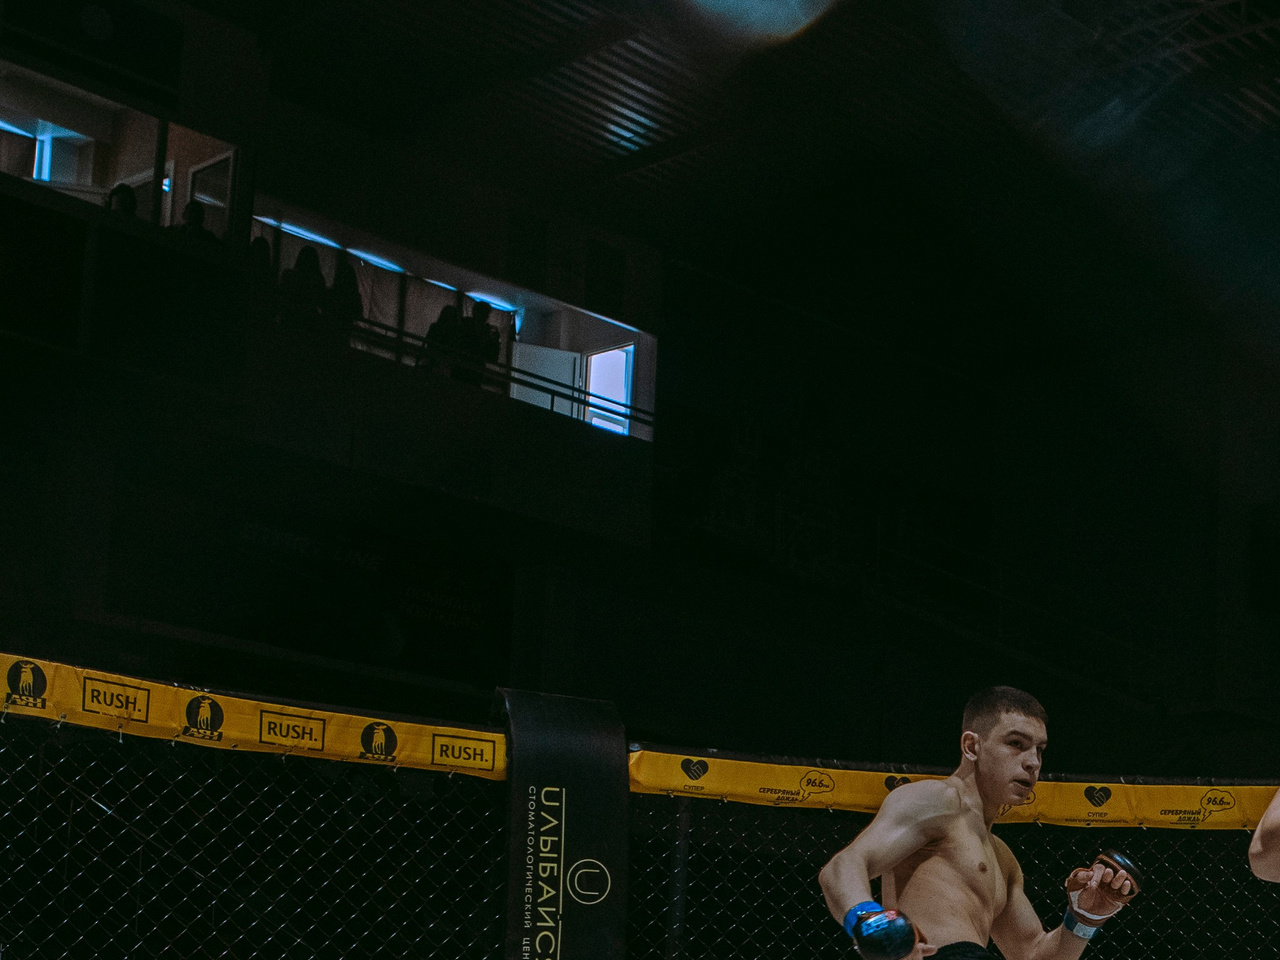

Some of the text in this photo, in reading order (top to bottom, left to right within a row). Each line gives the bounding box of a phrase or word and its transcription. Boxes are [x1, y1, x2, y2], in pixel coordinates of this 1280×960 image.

[91, 688, 142, 713] RUSH.
[267, 721, 318, 742] RUSH.
[439, 744, 489, 763] RUSH.
[759, 787, 801, 797] СЕРЕБРЯНЫЙ
[1160, 808, 1201, 816] СЕРЕБРЯНЫЙ
[524, 785, 537, 929] СТОМАТОЛОГИЧЕСКИЙ
